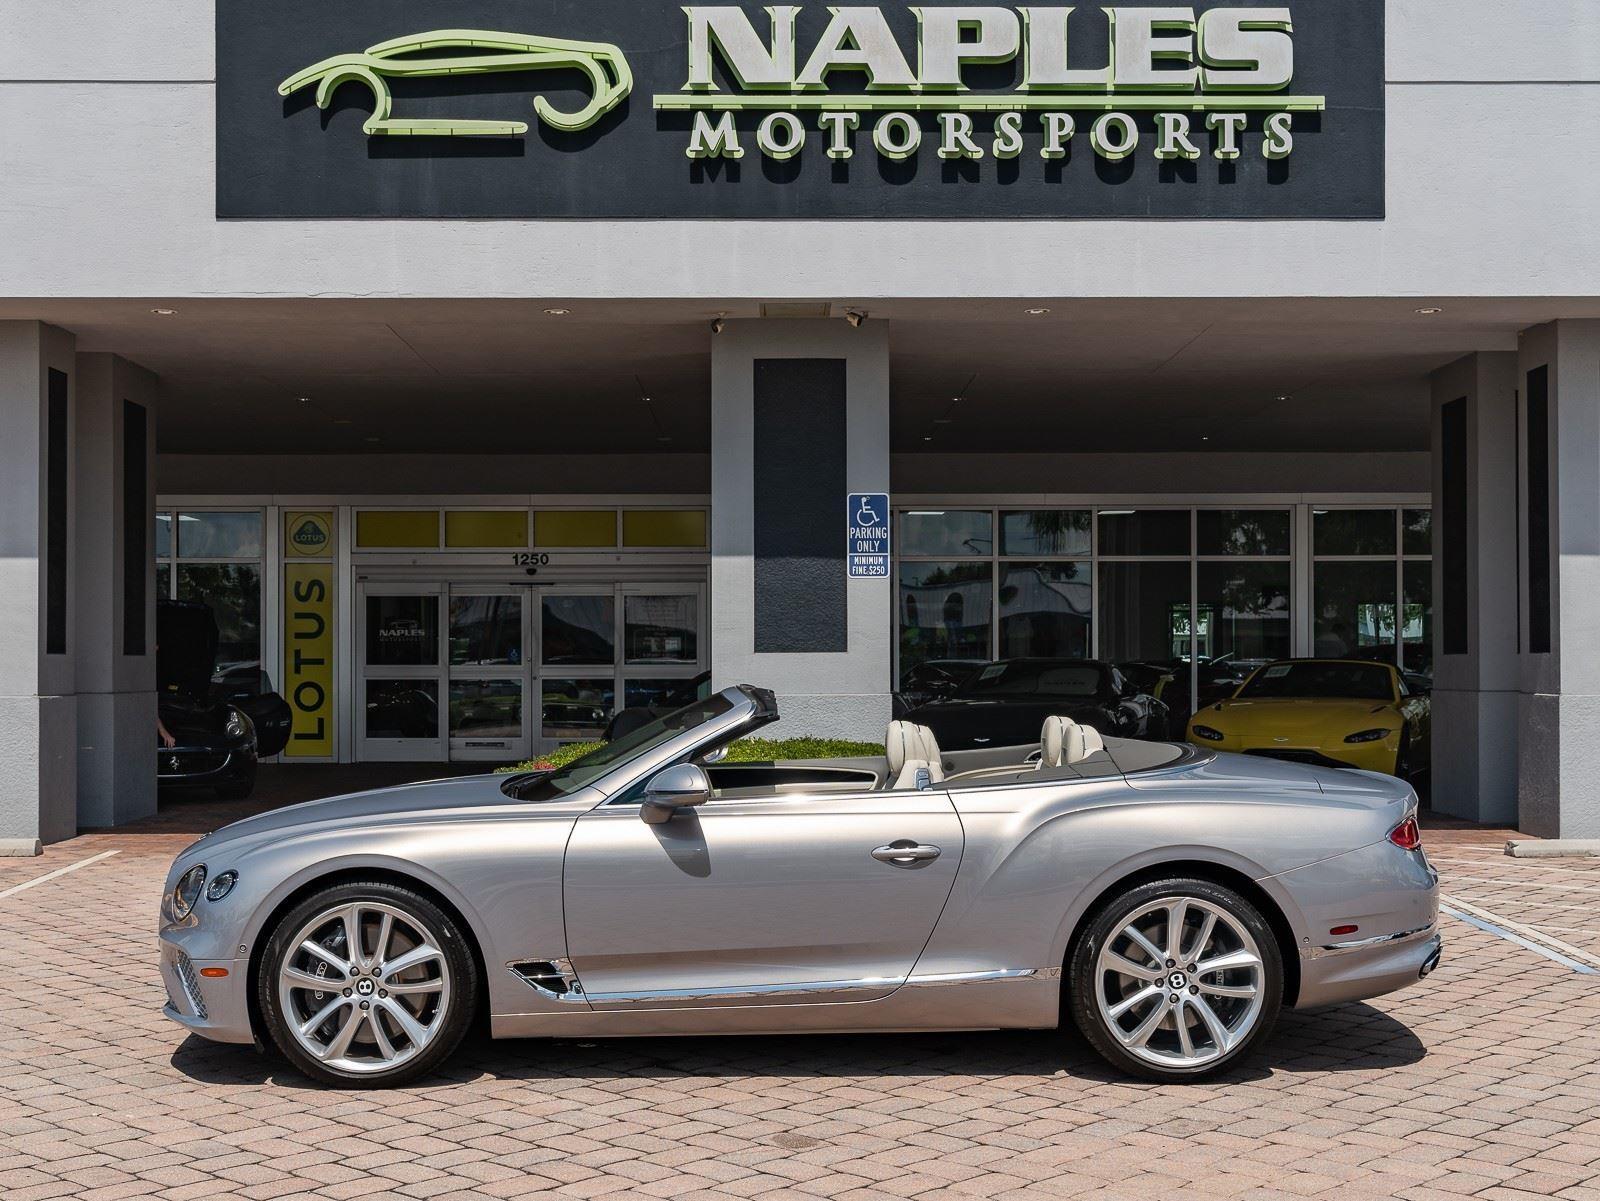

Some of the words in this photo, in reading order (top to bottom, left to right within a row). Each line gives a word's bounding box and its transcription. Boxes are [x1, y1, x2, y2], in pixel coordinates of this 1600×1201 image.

[682, 5, 1295, 91] NAPLES
[686, 112, 1294, 160] MOTORSPORTS
[295, 534, 324, 542] LOTUS
[850, 527, 887, 539] PARKING
[857, 541, 880, 552] ONLY
[512, 553, 549, 566] 1250
[854, 556, 883, 565] MINIMUM
[294, 579, 325, 740] LOTUS
